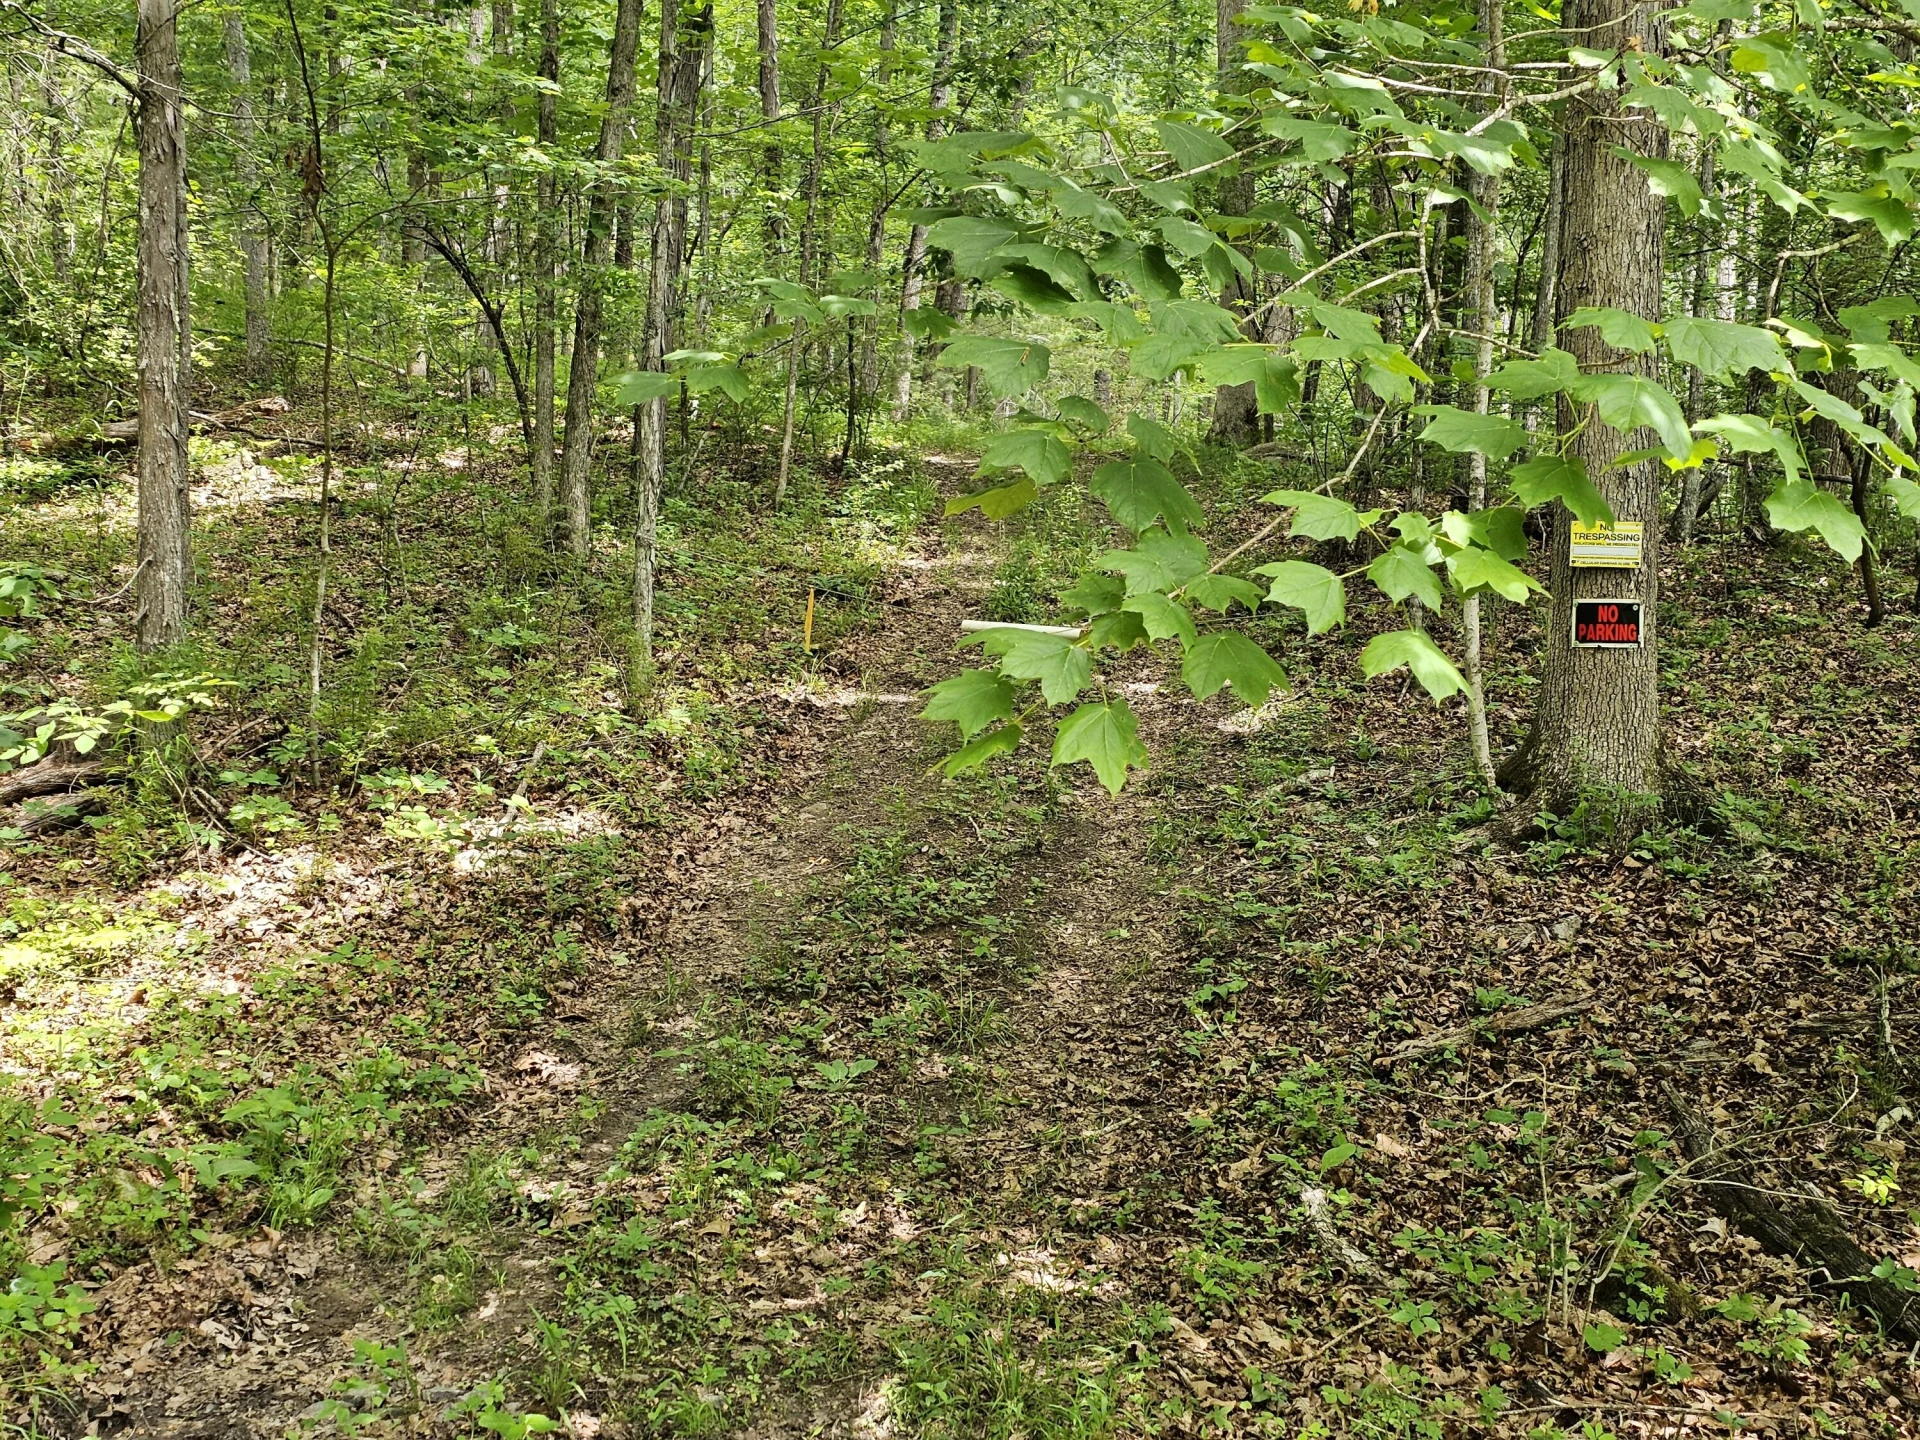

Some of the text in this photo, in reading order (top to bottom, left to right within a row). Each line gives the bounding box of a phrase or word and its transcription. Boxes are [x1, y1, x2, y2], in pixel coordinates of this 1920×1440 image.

[1573, 532, 1640, 541] TRESPASSING
[1598, 605, 1618, 622] NO
[1578, 624, 1636, 641] PARKING
